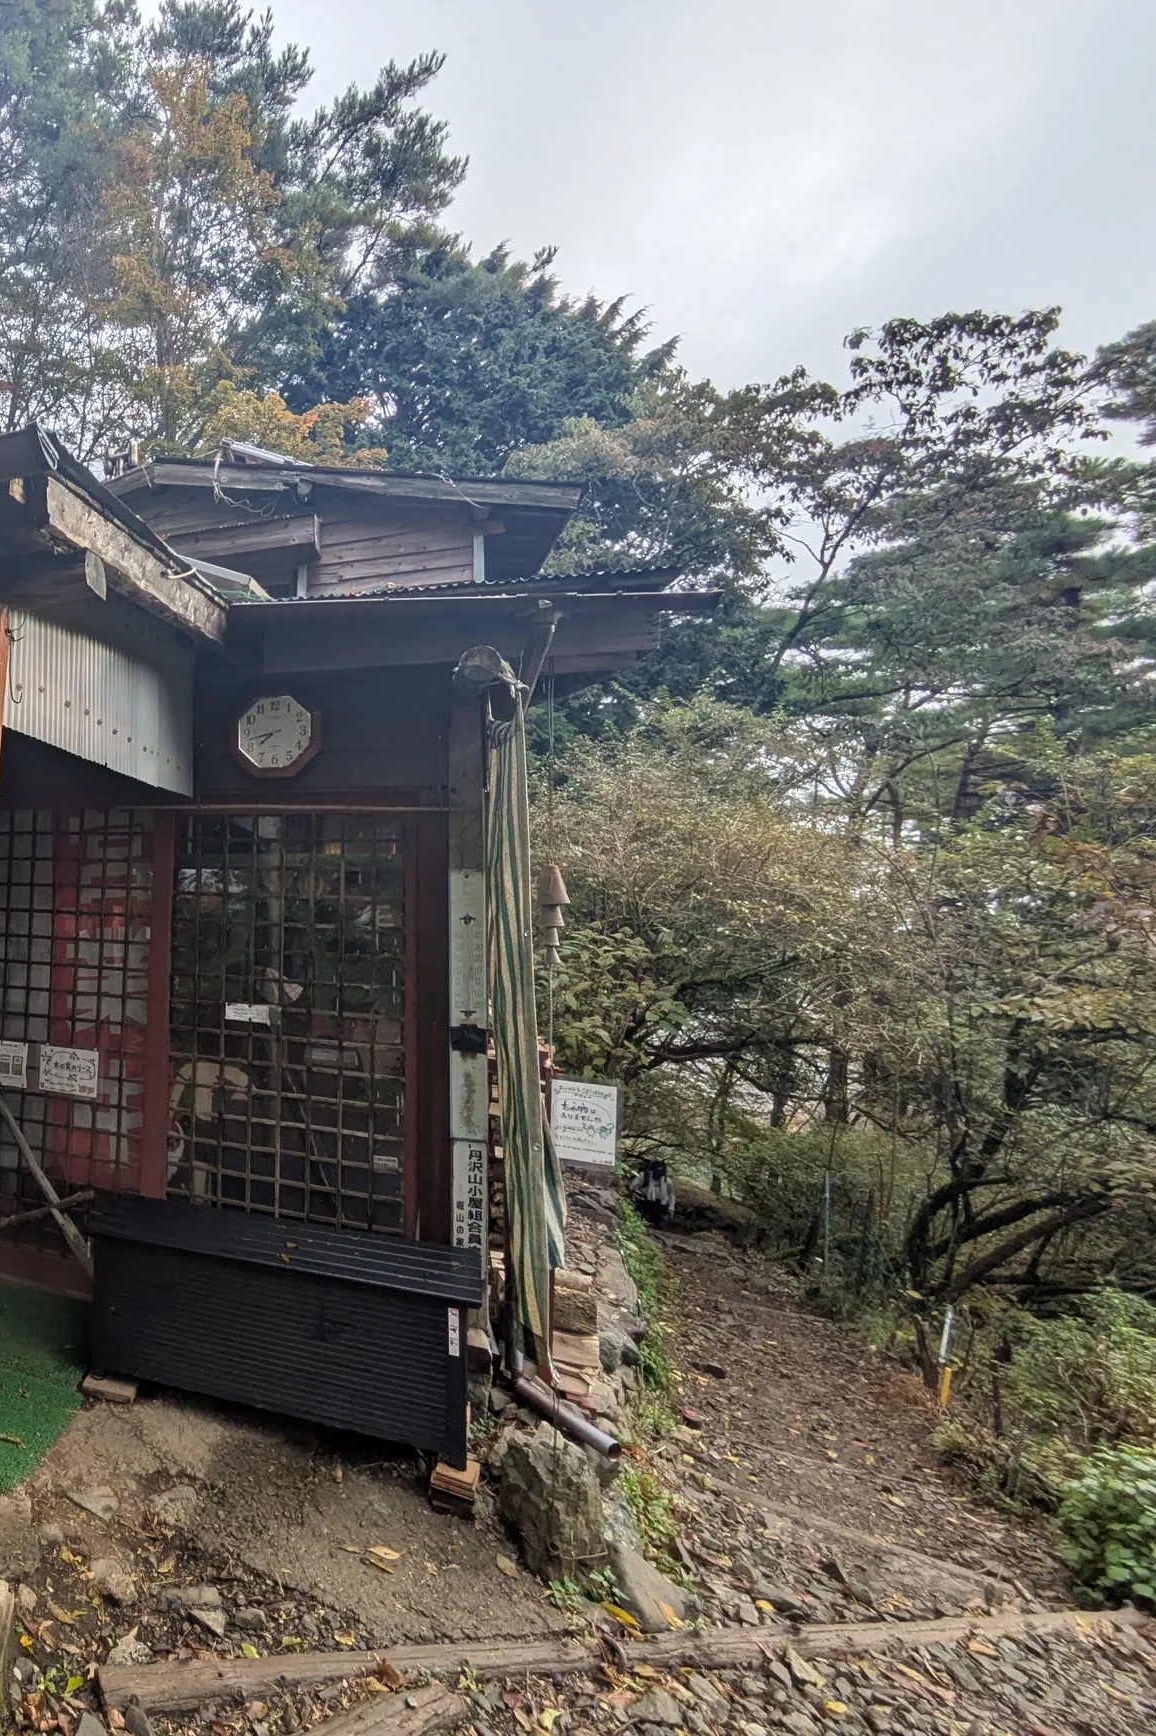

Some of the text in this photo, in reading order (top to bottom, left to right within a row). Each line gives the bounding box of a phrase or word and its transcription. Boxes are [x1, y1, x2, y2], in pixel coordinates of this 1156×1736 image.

[257, 703, 265, 714] 11
[270, 700, 280, 711] 12
[286, 703, 291, 713] 1
[246, 715, 256, 725] 10
[296, 712, 303, 722] 2
[243, 729, 250, 739] 9
[299, 725, 307, 736] 3
[247, 742, 254, 752] 8
[295, 739, 303, 750] 4
[258, 752, 265, 762] 7
[271, 754, 278, 764] 6
[286, 751, 293, 761] 5
[52, 1060, 93, 1074] 木の実のリース
